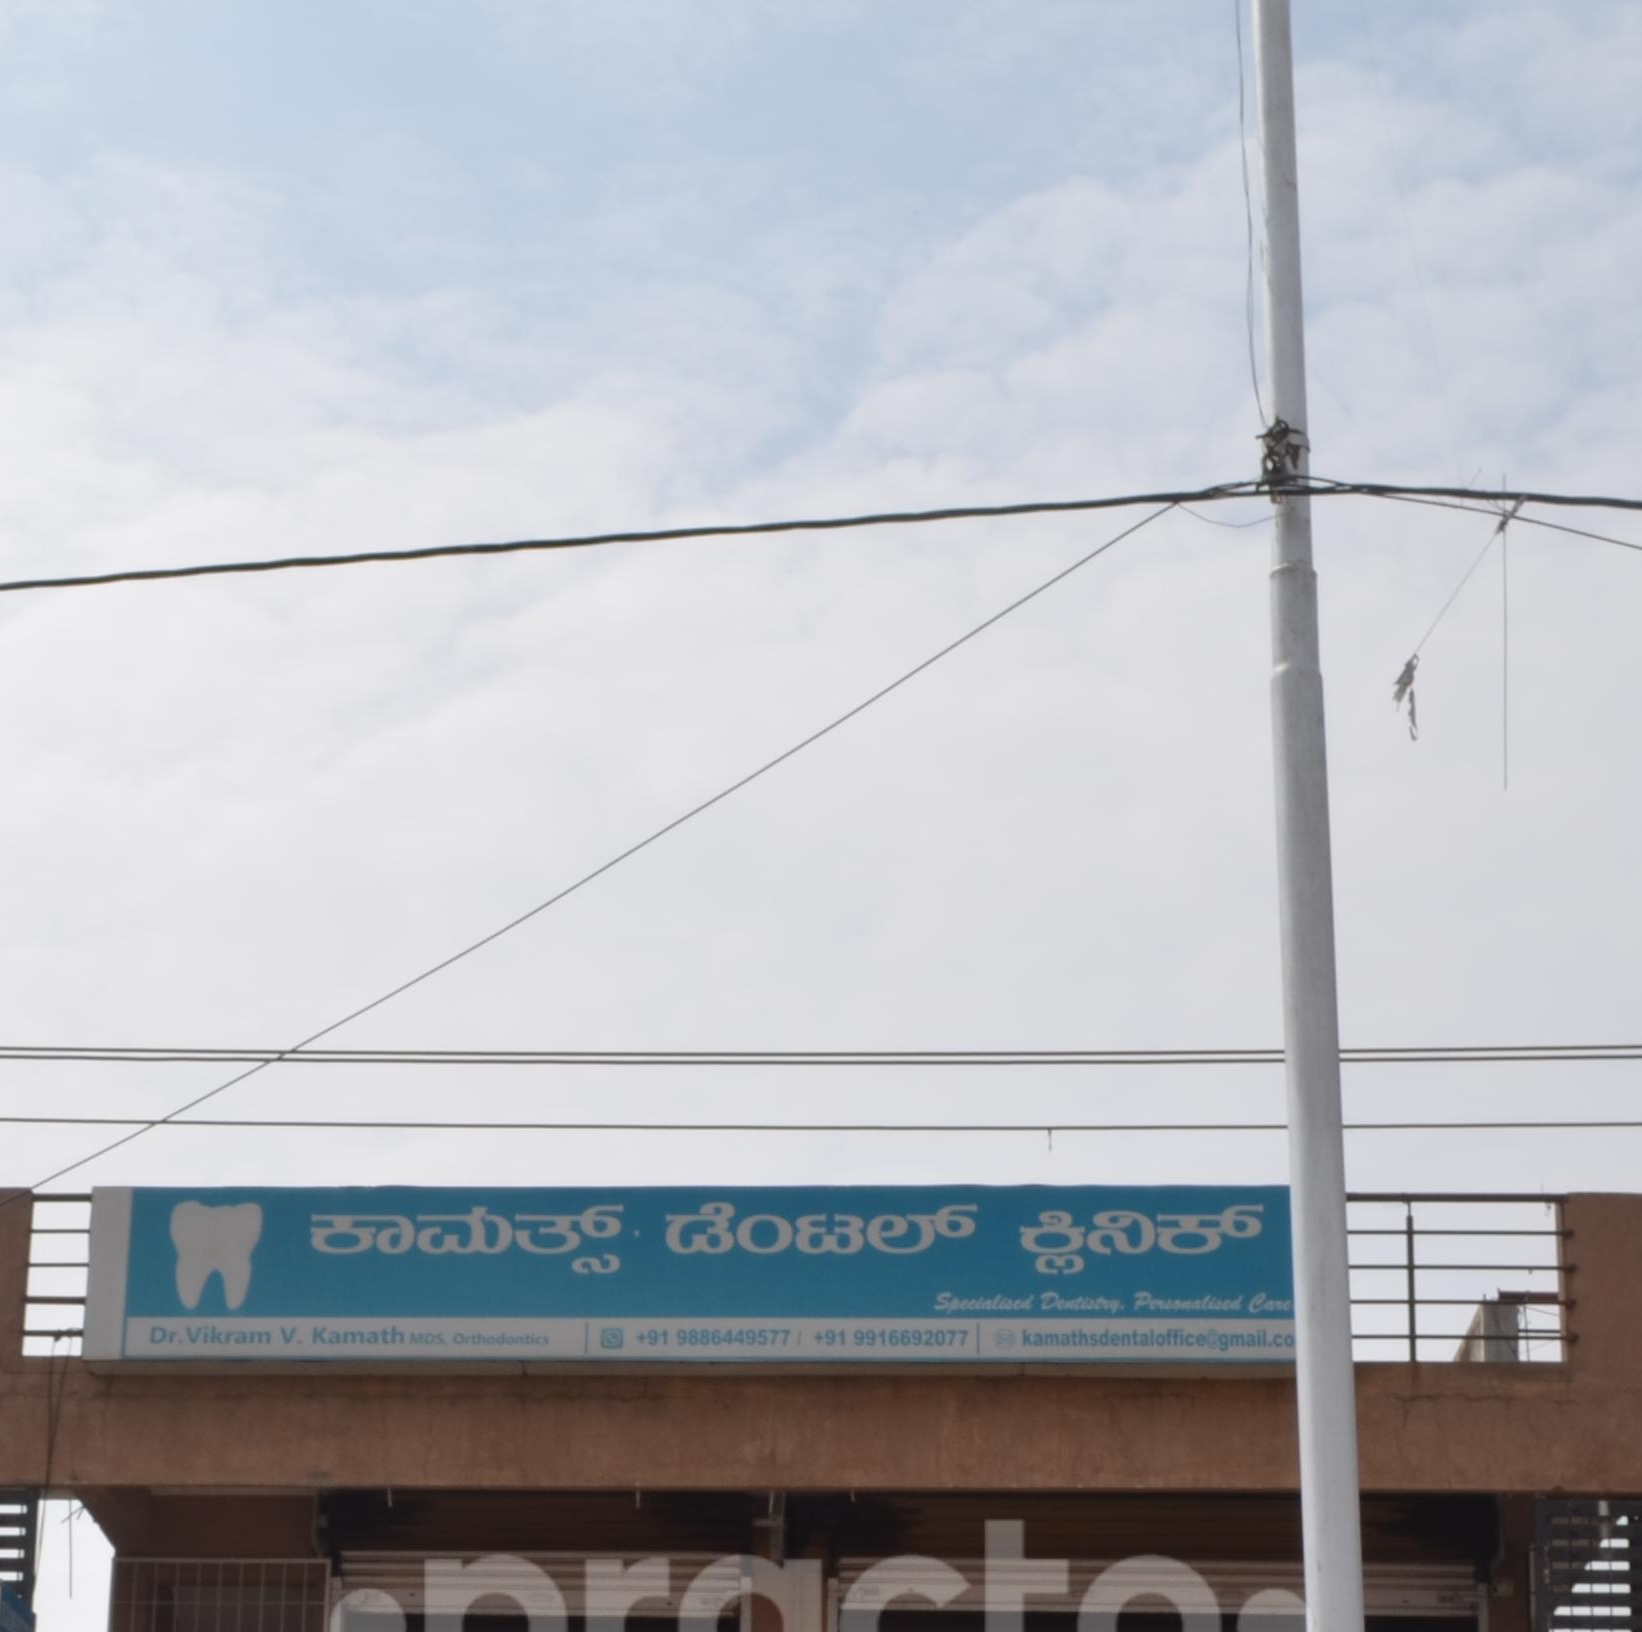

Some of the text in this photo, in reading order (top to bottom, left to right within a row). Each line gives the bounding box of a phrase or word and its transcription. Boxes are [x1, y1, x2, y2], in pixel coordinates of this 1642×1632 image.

[310, 1201, 1263, 1274] ಕಾಮತ್ಸ್ ಡೆಂಟಲ್ ಕ್ಲಿನಿಕ್
[934, 1291, 1034, 1313] Specialised
[1134, 1292, 1242, 1313] Personalised
[280, 1327, 303, 1345] V.
[312, 1326, 405, 1346] Kamath
[453, 1332, 550, 1347] Orthodontics
[636, 1329, 668, 1347] +91
[676, 1329, 791, 1347] 9886449577
[814, 1330, 846, 1347] +91
[854, 1330, 969, 1347] 9916692077
[1022, 1329, 1295, 1349] kamathsdentaloffice@gmail.co
